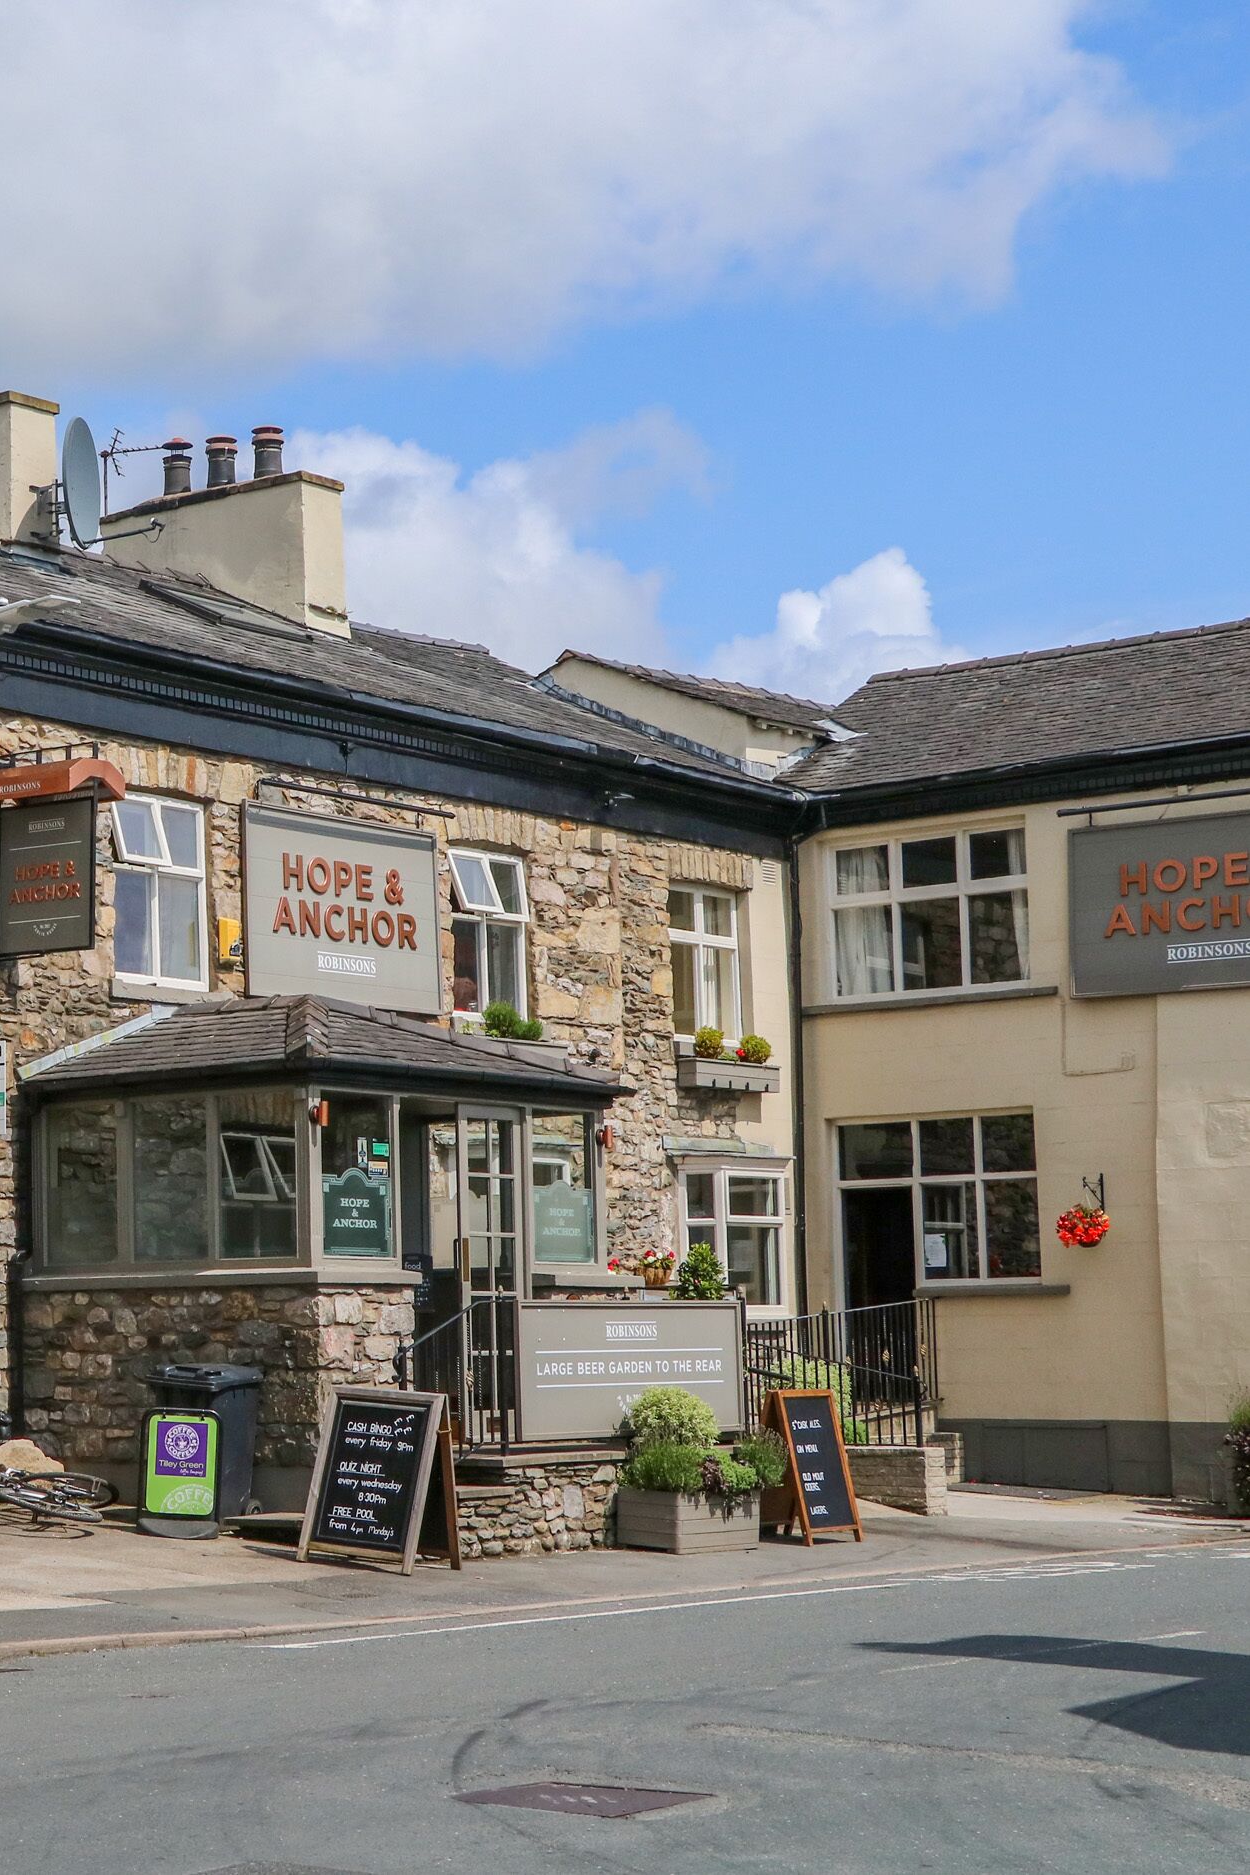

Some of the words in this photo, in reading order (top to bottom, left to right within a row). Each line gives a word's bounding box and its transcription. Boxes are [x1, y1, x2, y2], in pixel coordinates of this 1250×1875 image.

[0, 781, 41, 793] ROBINSONS
[29, 820, 65, 831] ROBINSONS
[14, 861, 60, 882] HOPE
[65, 860, 75, 877] &
[1119, 852, 1250, 897] HOPE
[282, 853, 374, 901] HOPE
[384, 869, 404, 905] &
[9, 882, 81, 904] ANCHOR
[272, 896, 417, 950] ANCHOR
[1104, 895, 1250, 938] ANCH
[318, 954, 376, 974] ROBINSONS
[340, 1198, 370, 1207] HOPE
[352, 1208, 359, 1217] &
[549, 1208, 575, 1217] HOPE
[332, 1218, 378, 1229] ANCHOR
[558, 1218, 565, 1226] &
[606, 1324, 658, 1338] ROBINSONS
[536, 1362, 573, 1376] LARGE
[577, 1361, 605, 1375] BEER
[608, 1361, 652, 1374] GARDEN
[655, 1360, 670, 1373] TO
[672, 1360, 692, 1372] THE
[696, 1359, 722, 1372] REAR
[347, 1421, 367, 1433] CASH
[369, 1422, 392, 1435] BINGO
[345, 1437, 366, 1449] every
[369, 1436, 392, 1451] friday
[158, 1459, 177, 1469] Tilley
[179, 1460, 204, 1469] Green
[339, 1461, 358, 1471] QUIZ
[360, 1461, 382, 1474] NIGHT
[337, 1477, 359, 1489] every
[361, 1478, 402, 1494] wednesday
[332, 1506, 353, 1518] FREE
[355, 1508, 375, 1520] POOL
[329, 1519, 347, 1531] from
[368, 1526, 394, 1541] Monday's
